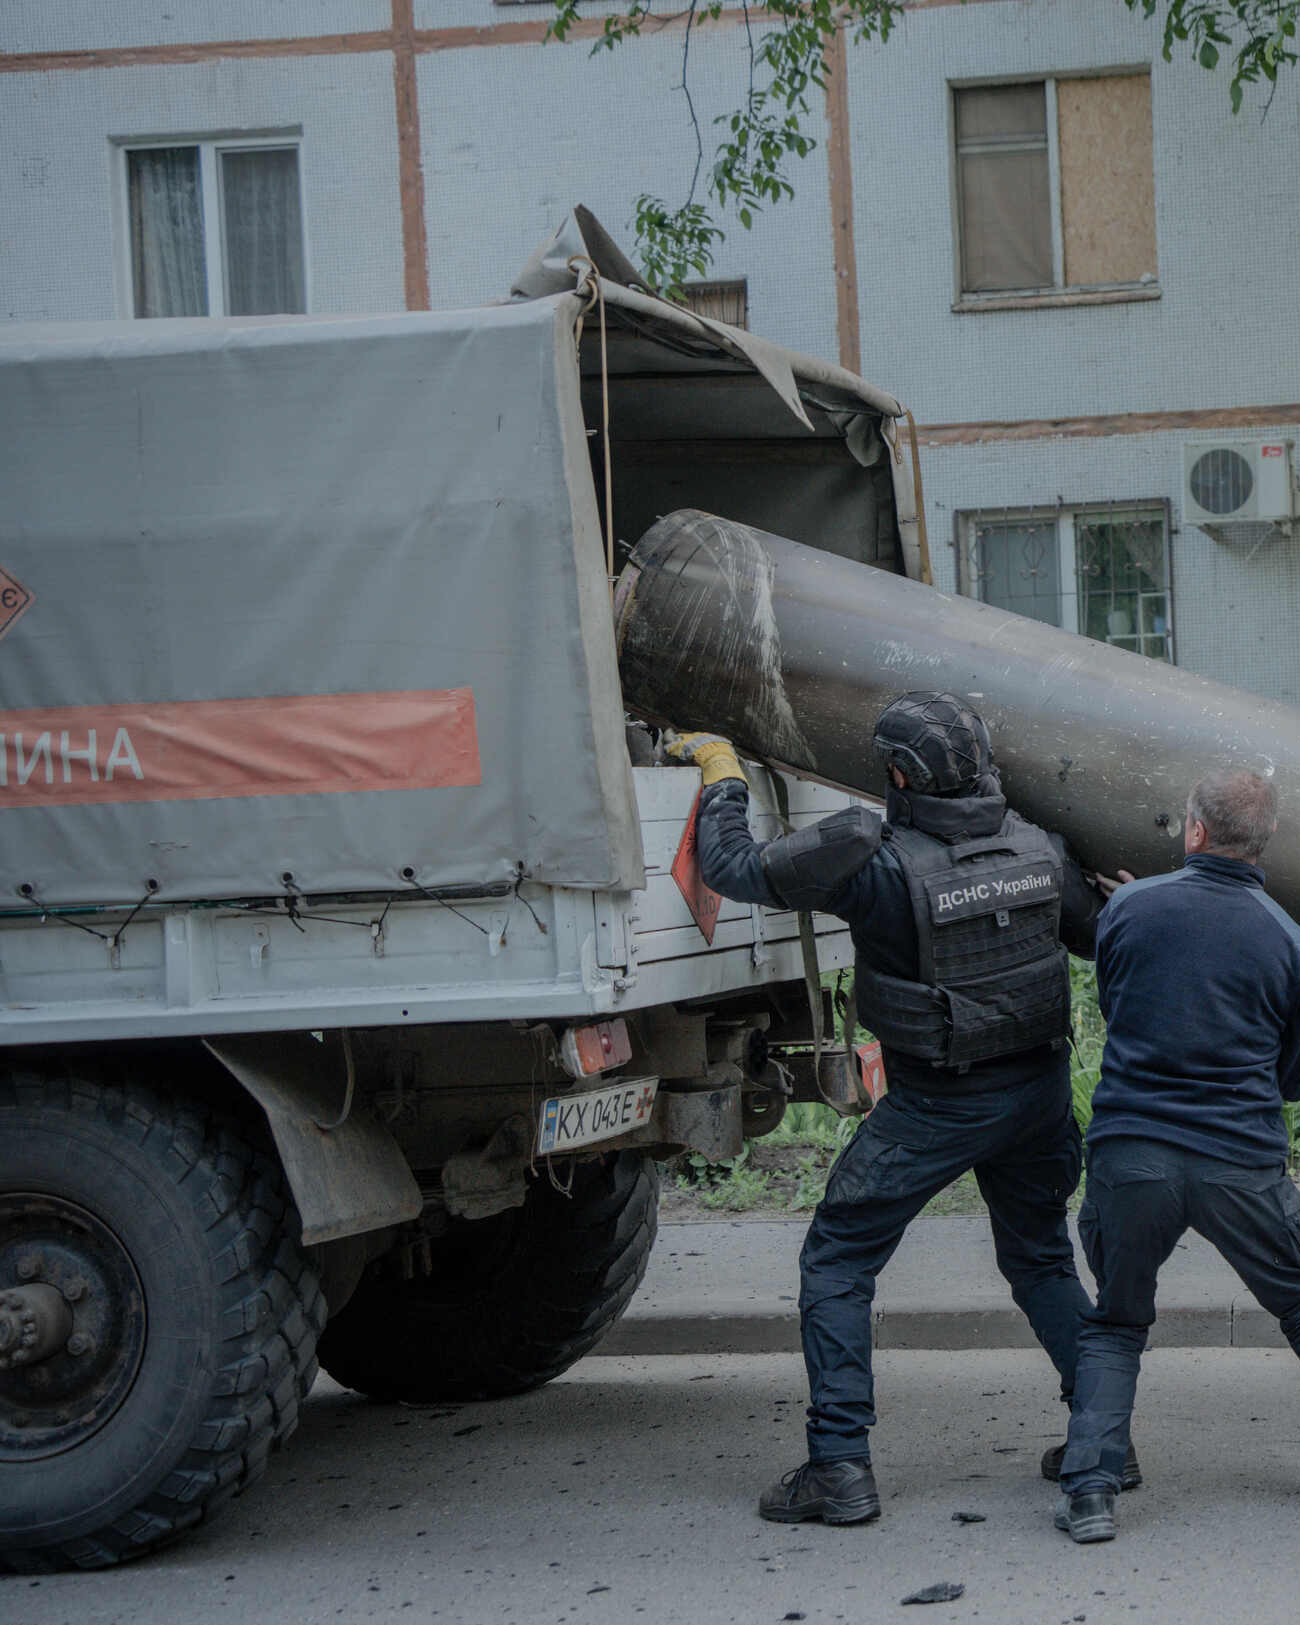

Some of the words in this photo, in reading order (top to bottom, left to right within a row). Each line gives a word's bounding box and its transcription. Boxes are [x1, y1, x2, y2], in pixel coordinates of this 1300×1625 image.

[0, 727, 145, 787] ИНА
[938, 884, 990, 912] ДСНС
[992, 874, 1051, 896] України
